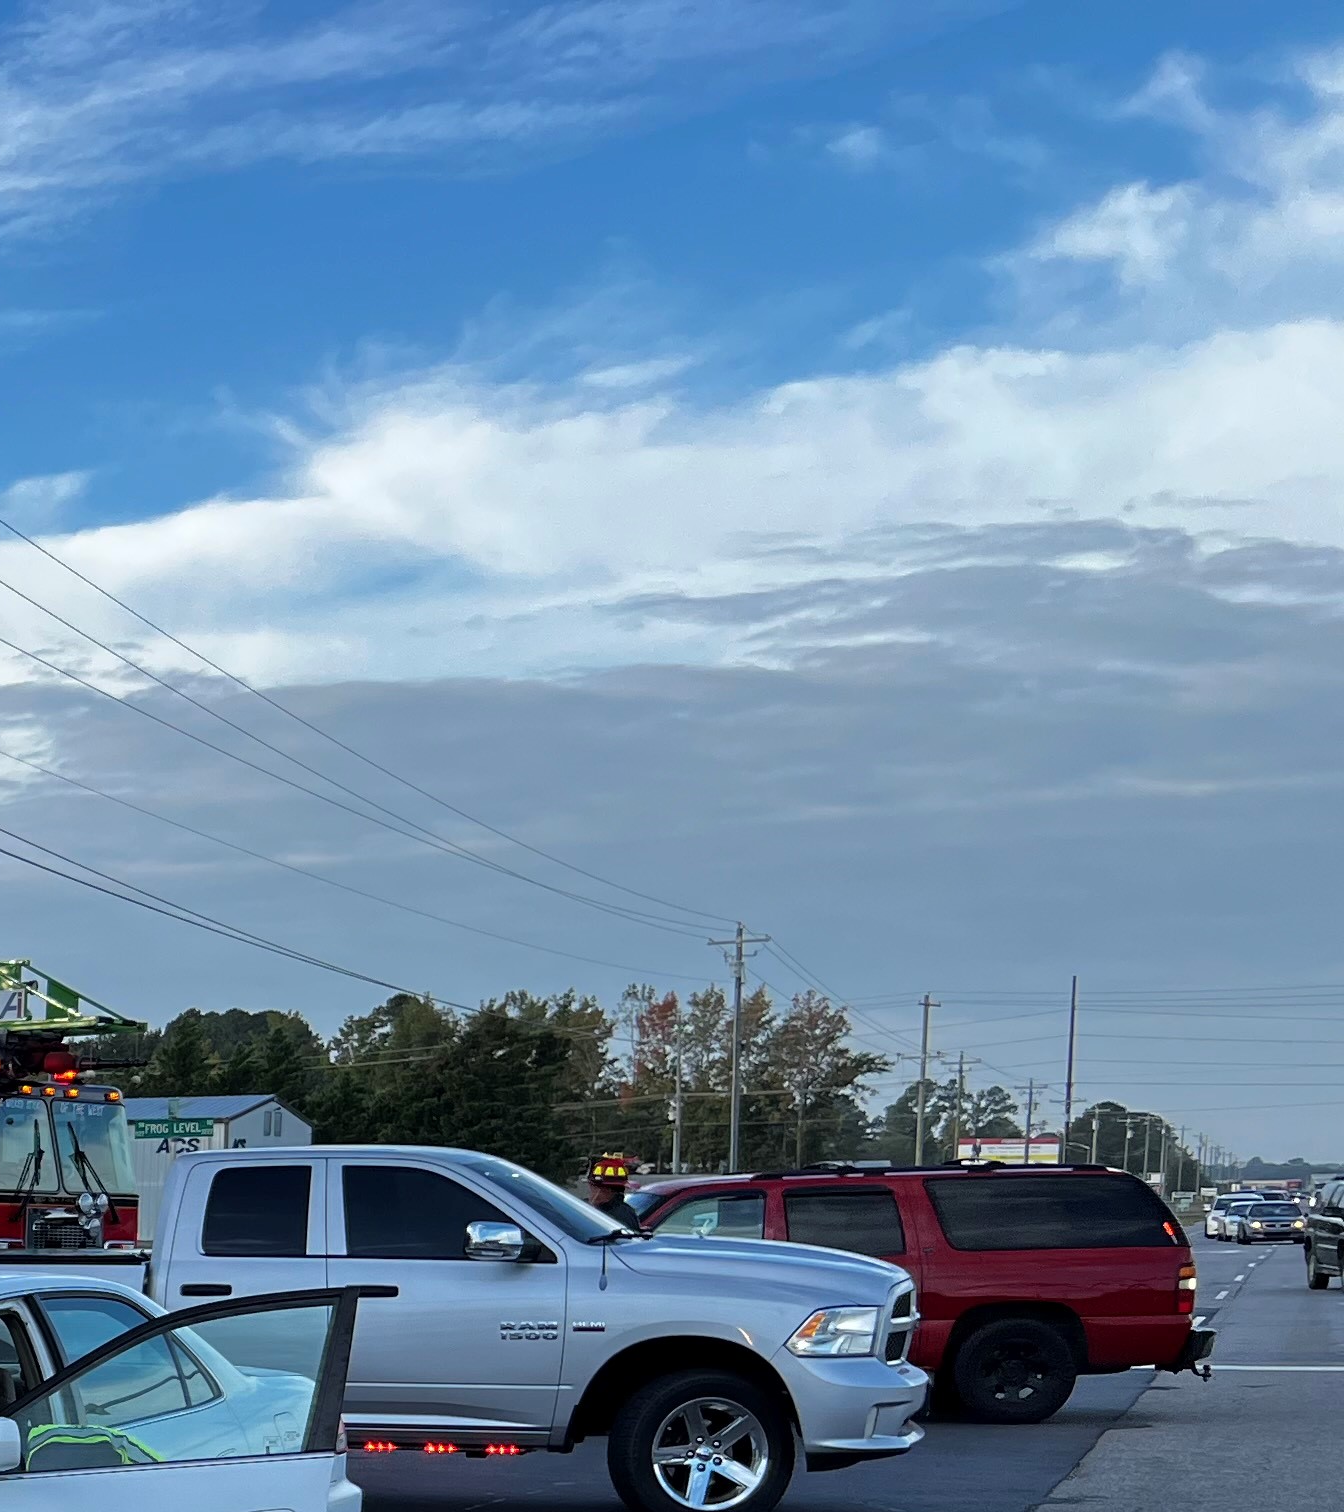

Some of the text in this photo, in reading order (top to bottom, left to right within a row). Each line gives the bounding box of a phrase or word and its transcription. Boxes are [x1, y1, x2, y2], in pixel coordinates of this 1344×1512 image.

[144, 1122, 169, 1135] FROG
[173, 1122, 201, 1134] LEVEL
[500, 1321, 558, 1330] RAM
[500, 1331, 558, 1341] 1500
